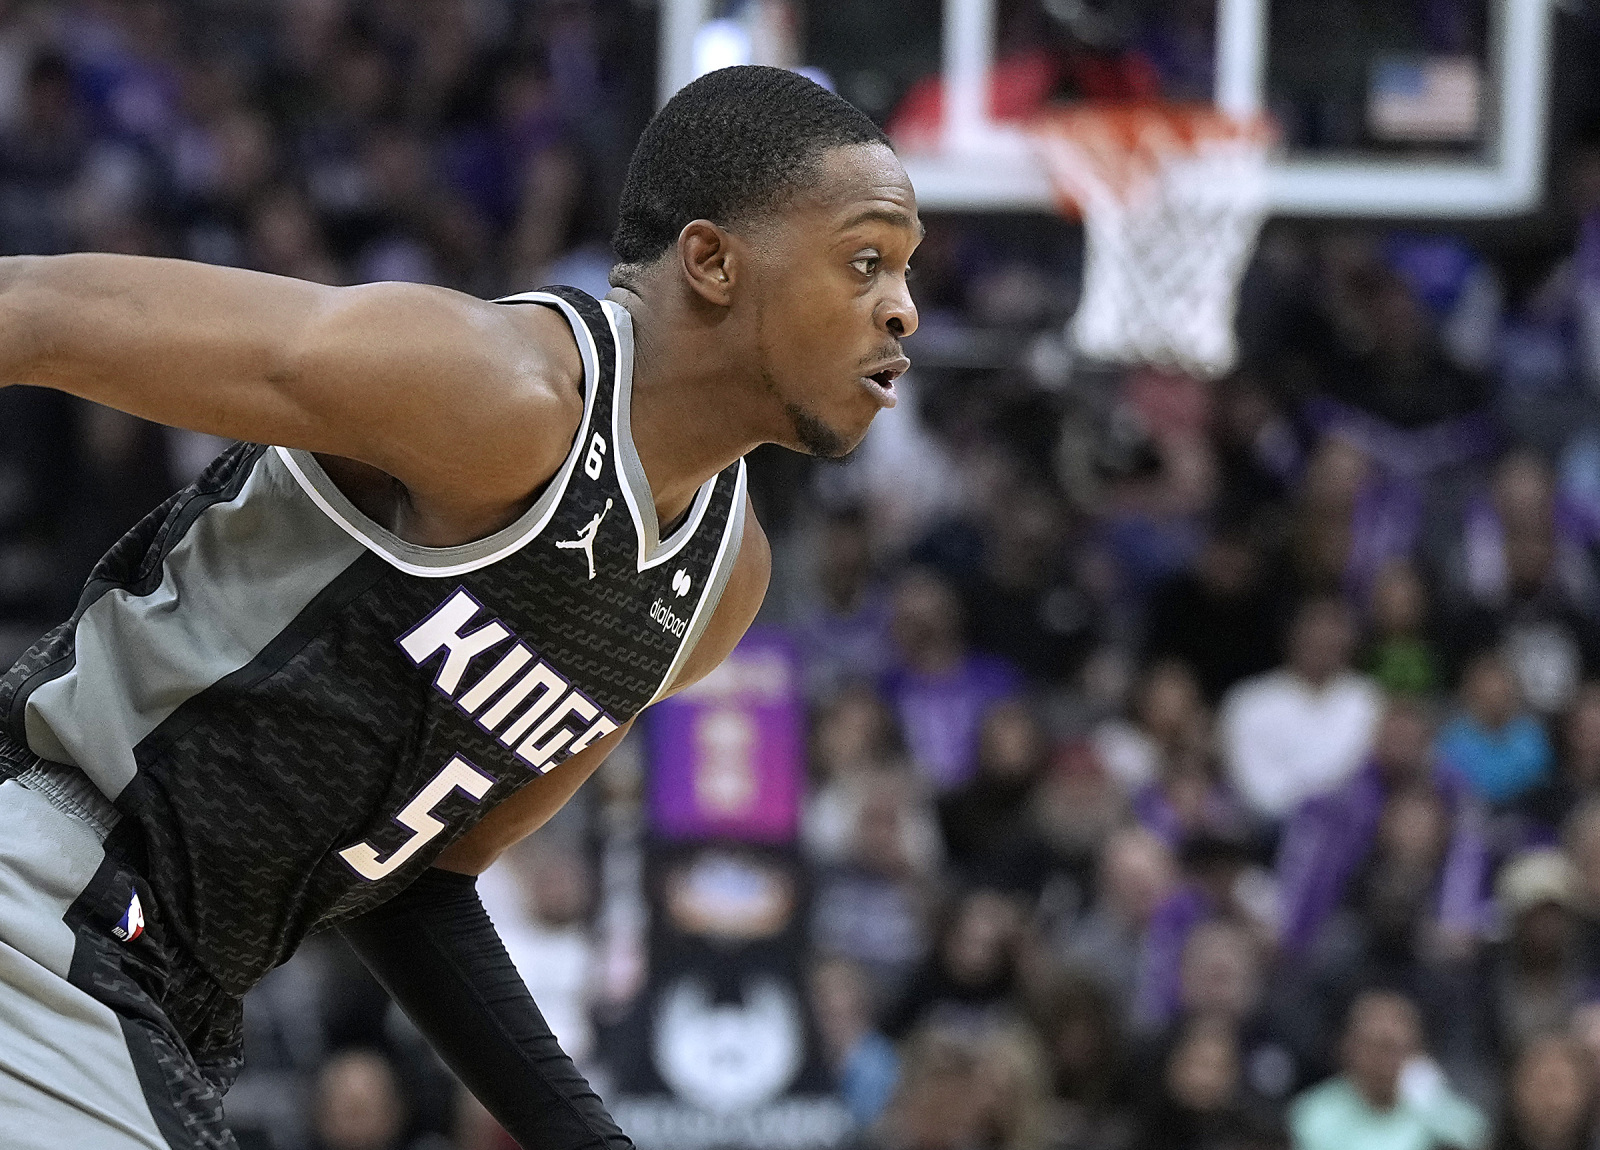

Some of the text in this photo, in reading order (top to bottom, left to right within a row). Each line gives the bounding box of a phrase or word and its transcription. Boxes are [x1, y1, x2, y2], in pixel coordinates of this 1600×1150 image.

[584, 431, 607, 481] 6
[649, 598, 689, 639] dialpad
[337, 755, 497, 881] 5
